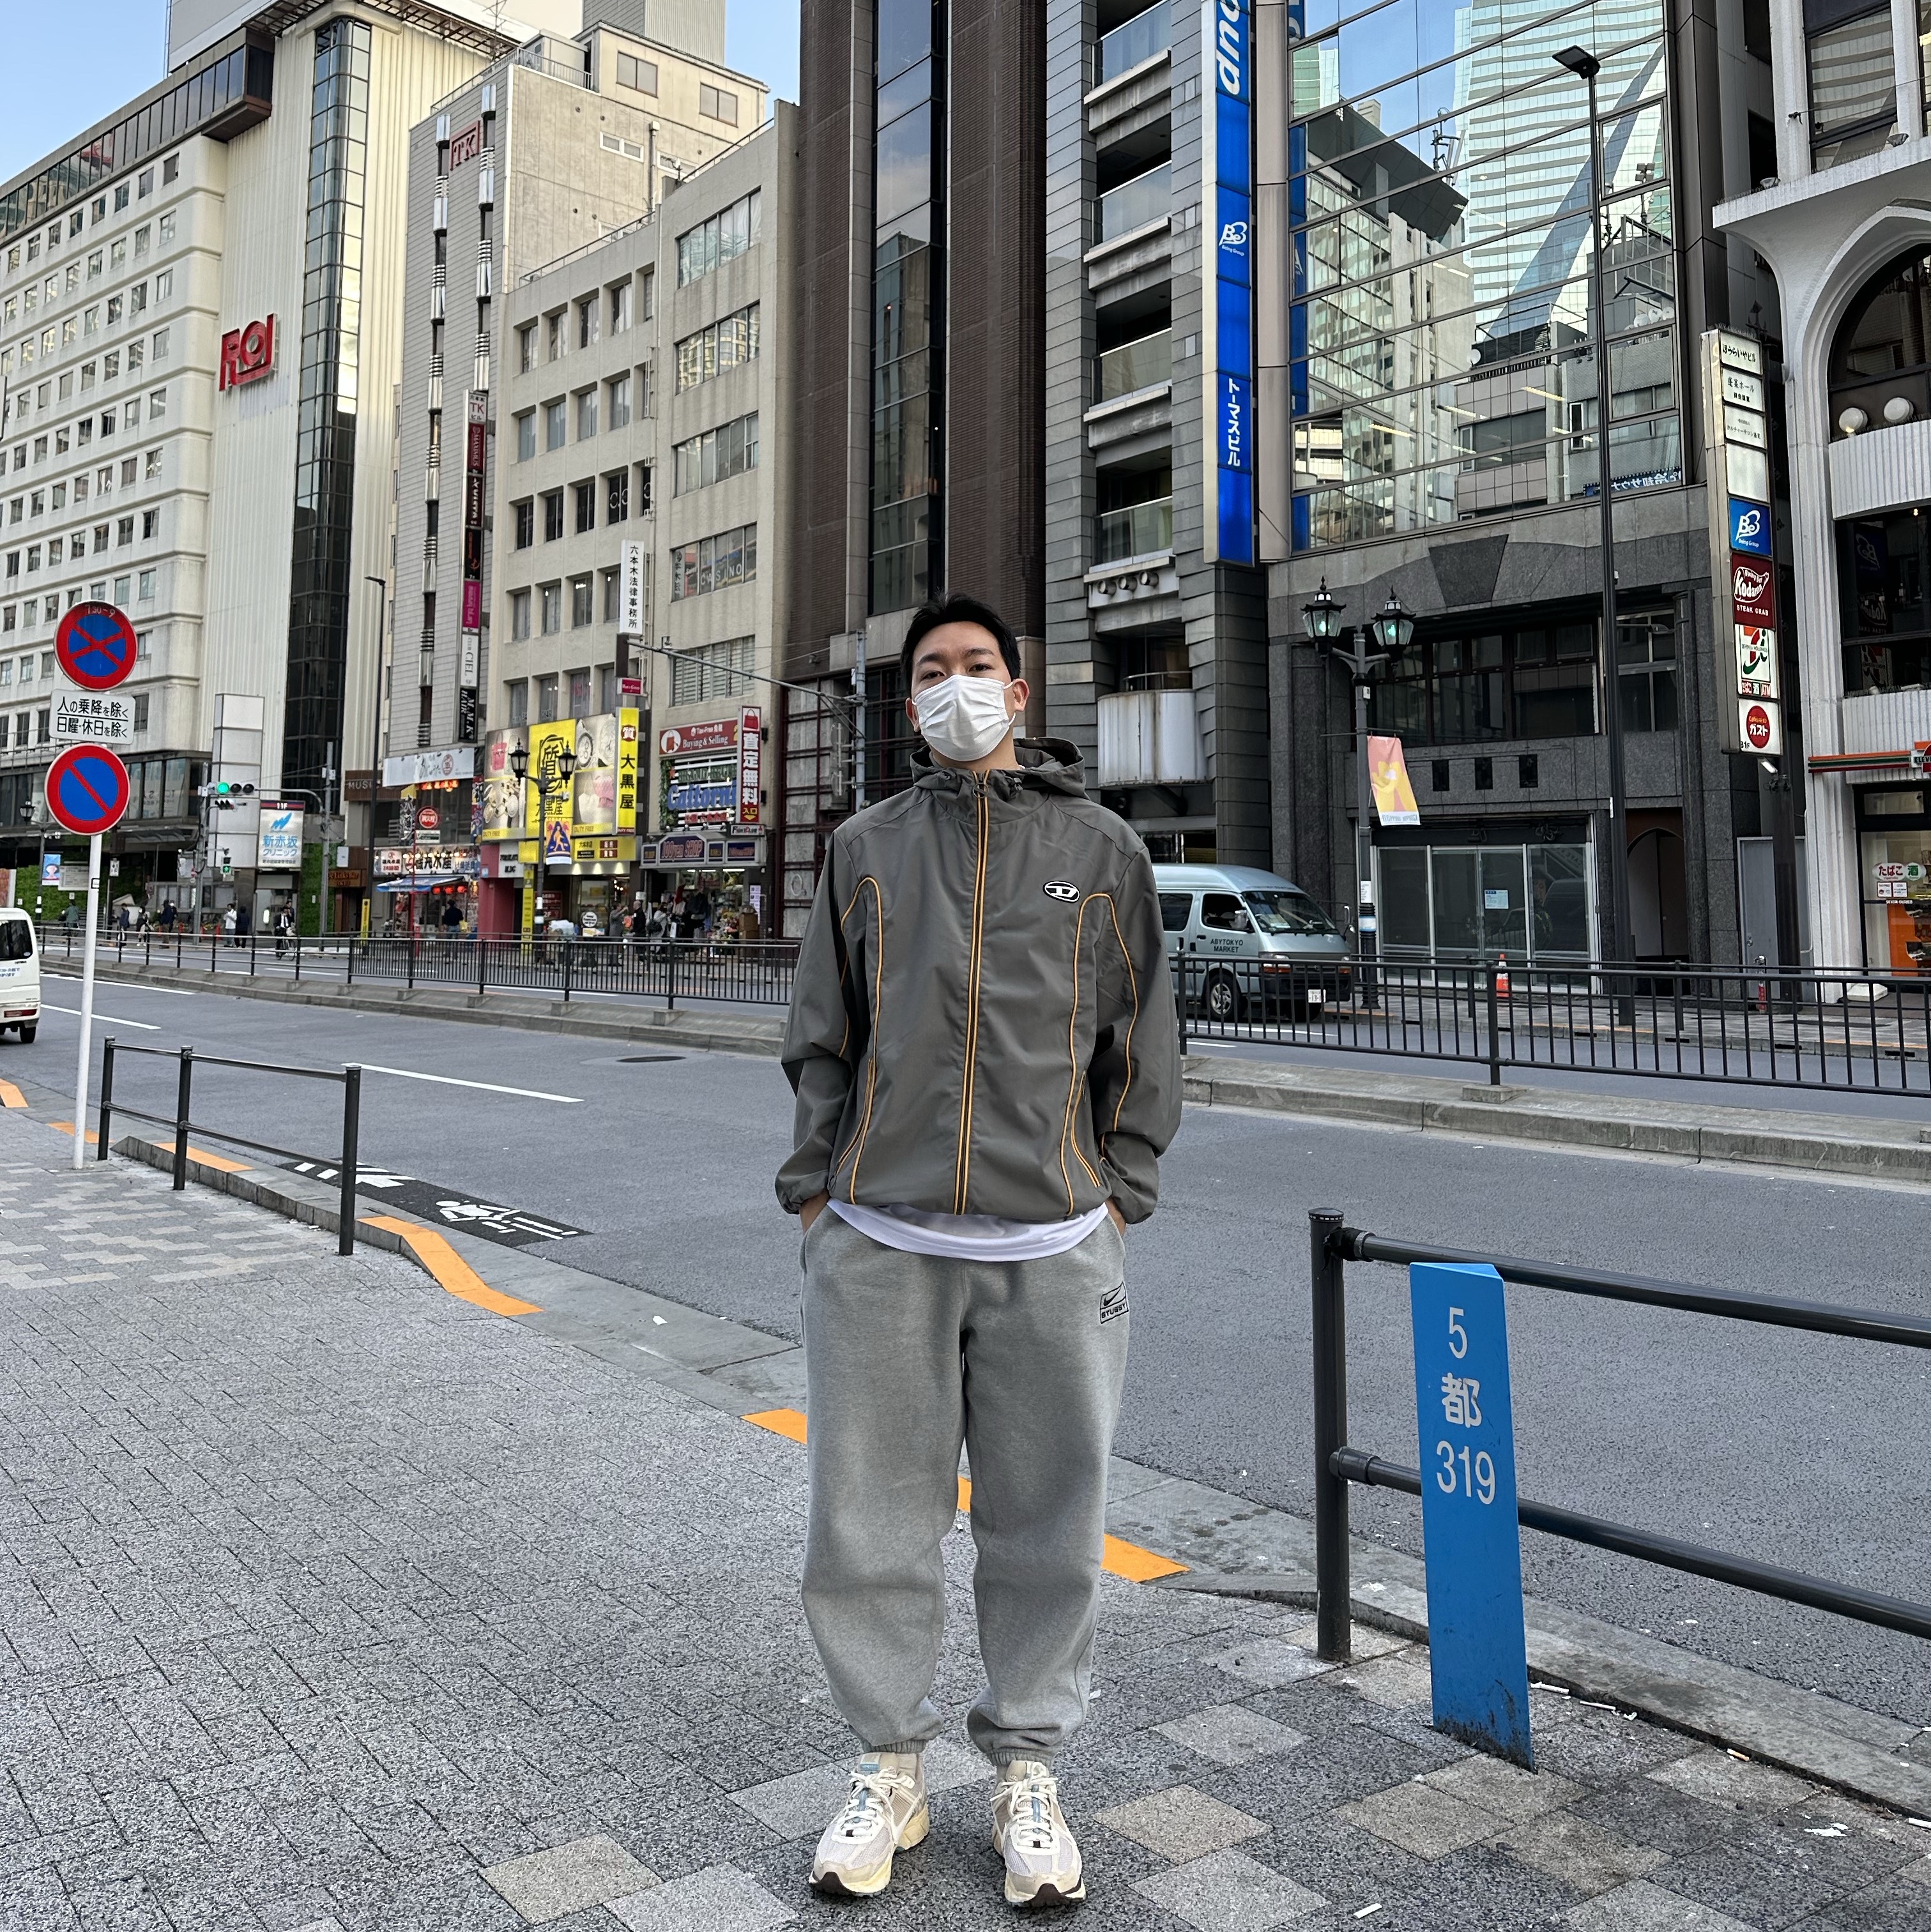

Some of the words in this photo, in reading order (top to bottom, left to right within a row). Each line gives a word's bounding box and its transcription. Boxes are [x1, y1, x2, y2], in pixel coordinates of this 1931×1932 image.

[1221, 244, 1233, 253] Being
[1233, 248, 1245, 257] Group
[219, 312, 277, 392] ROI
[1722, 344, 1756, 363] ほうらいやビル
[469, 402, 484, 415] TK
[1228, 377, 1240, 467] トーマスビル
[629, 545, 639, 628] 六本木法律事務所
[1737, 604, 1753, 614] STEAK
[1755, 607, 1769, 616] CRAB
[464, 651, 473, 677] CIEL
[1761, 683, 1771, 697] ATM
[57, 696, 128, 718] 人の乗降を除く
[57, 717, 128, 738] 日曜・休日を除く
[1750, 724, 1768, 736] ガスト
[683, 737, 703, 750] Buying
[708, 734, 728, 746] Selling
[347, 780, 374, 790] MUSI
[620, 754, 636, 809] 大黒屋
[263, 835, 298, 849] 新赤坂
[684, 840, 703, 858] SHOP
[263, 848, 298, 856] クリニック
[1879, 865, 1904, 876] たばこ
[1448, 1307, 1468, 1359] 5
[1441, 1372, 1482, 1428] 都
[1436, 1440, 1496, 1505] 319
